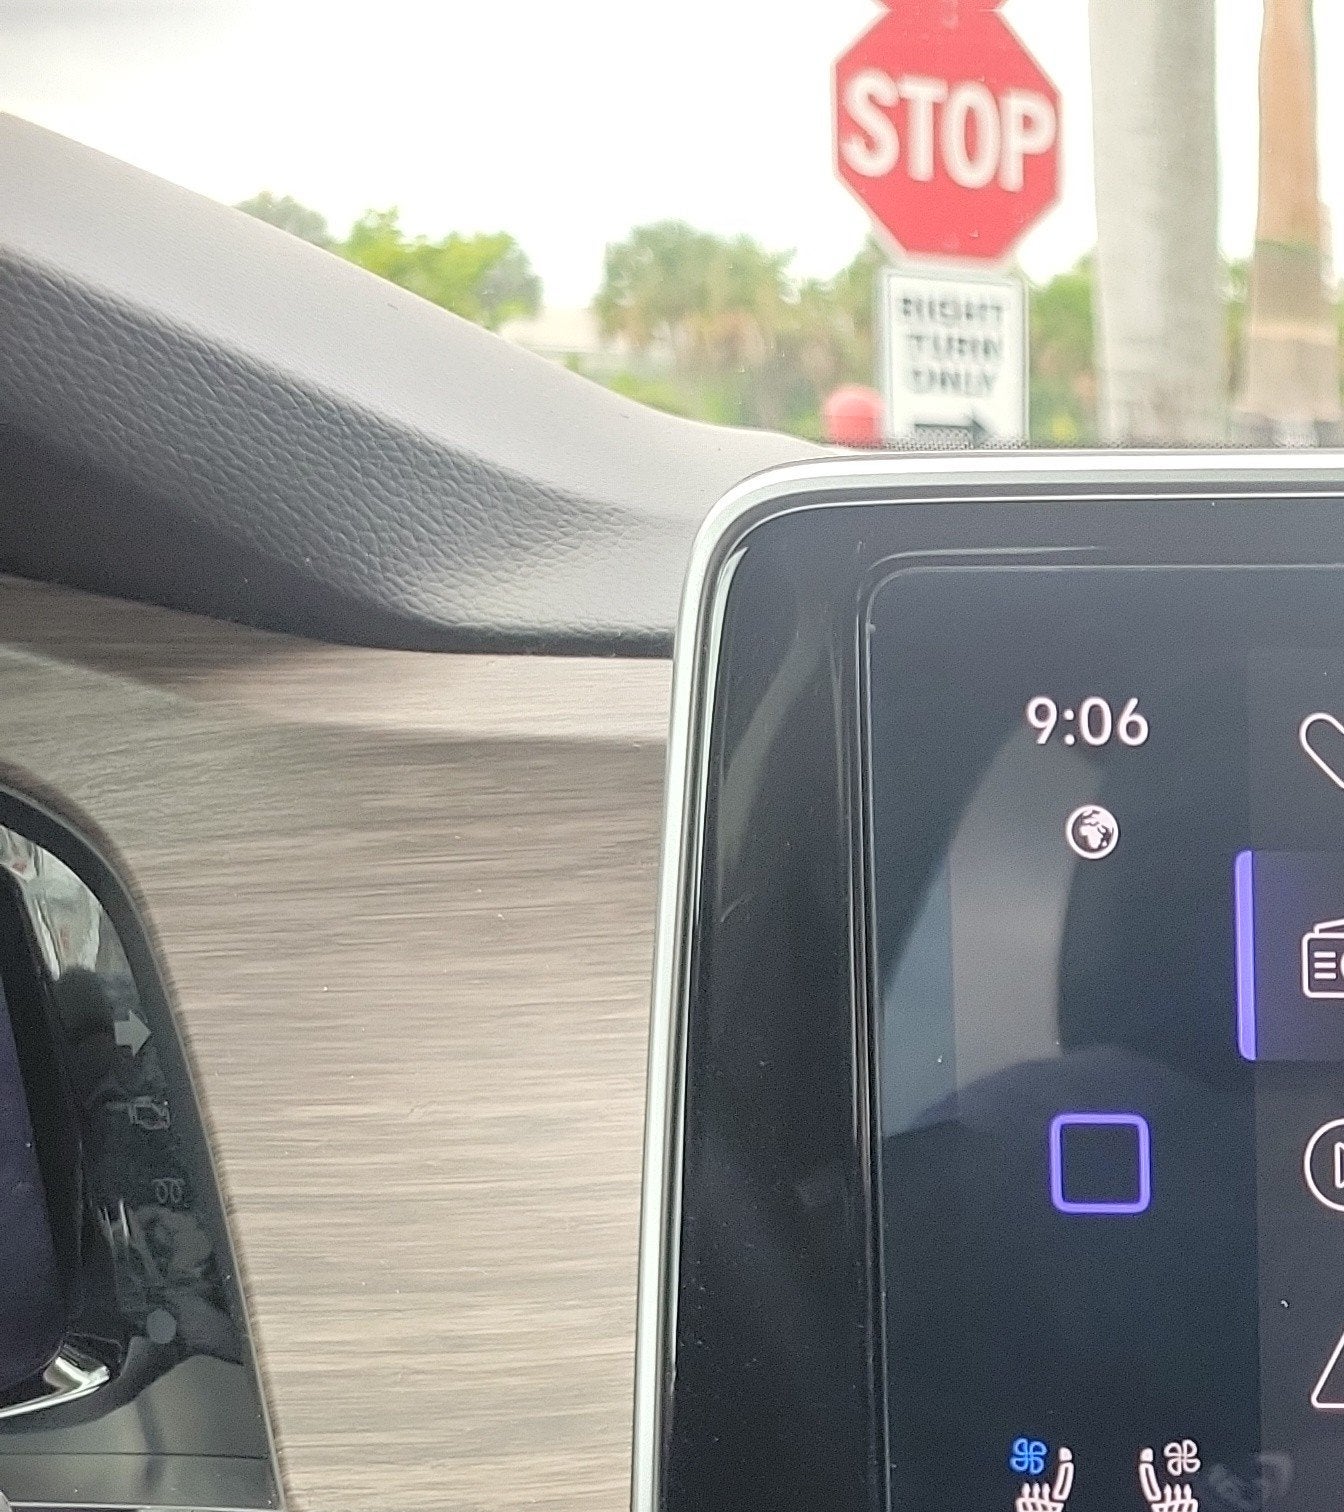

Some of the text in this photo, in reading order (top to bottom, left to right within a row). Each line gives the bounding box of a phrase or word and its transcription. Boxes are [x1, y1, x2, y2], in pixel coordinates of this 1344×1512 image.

[841, 69, 1057, 192] STOP
[901, 297, 1005, 327] RIGHT
[905, 331, 1003, 361] TURN
[907, 366, 996, 396] ONLY
[1027, 696, 1149, 746] 9:06
